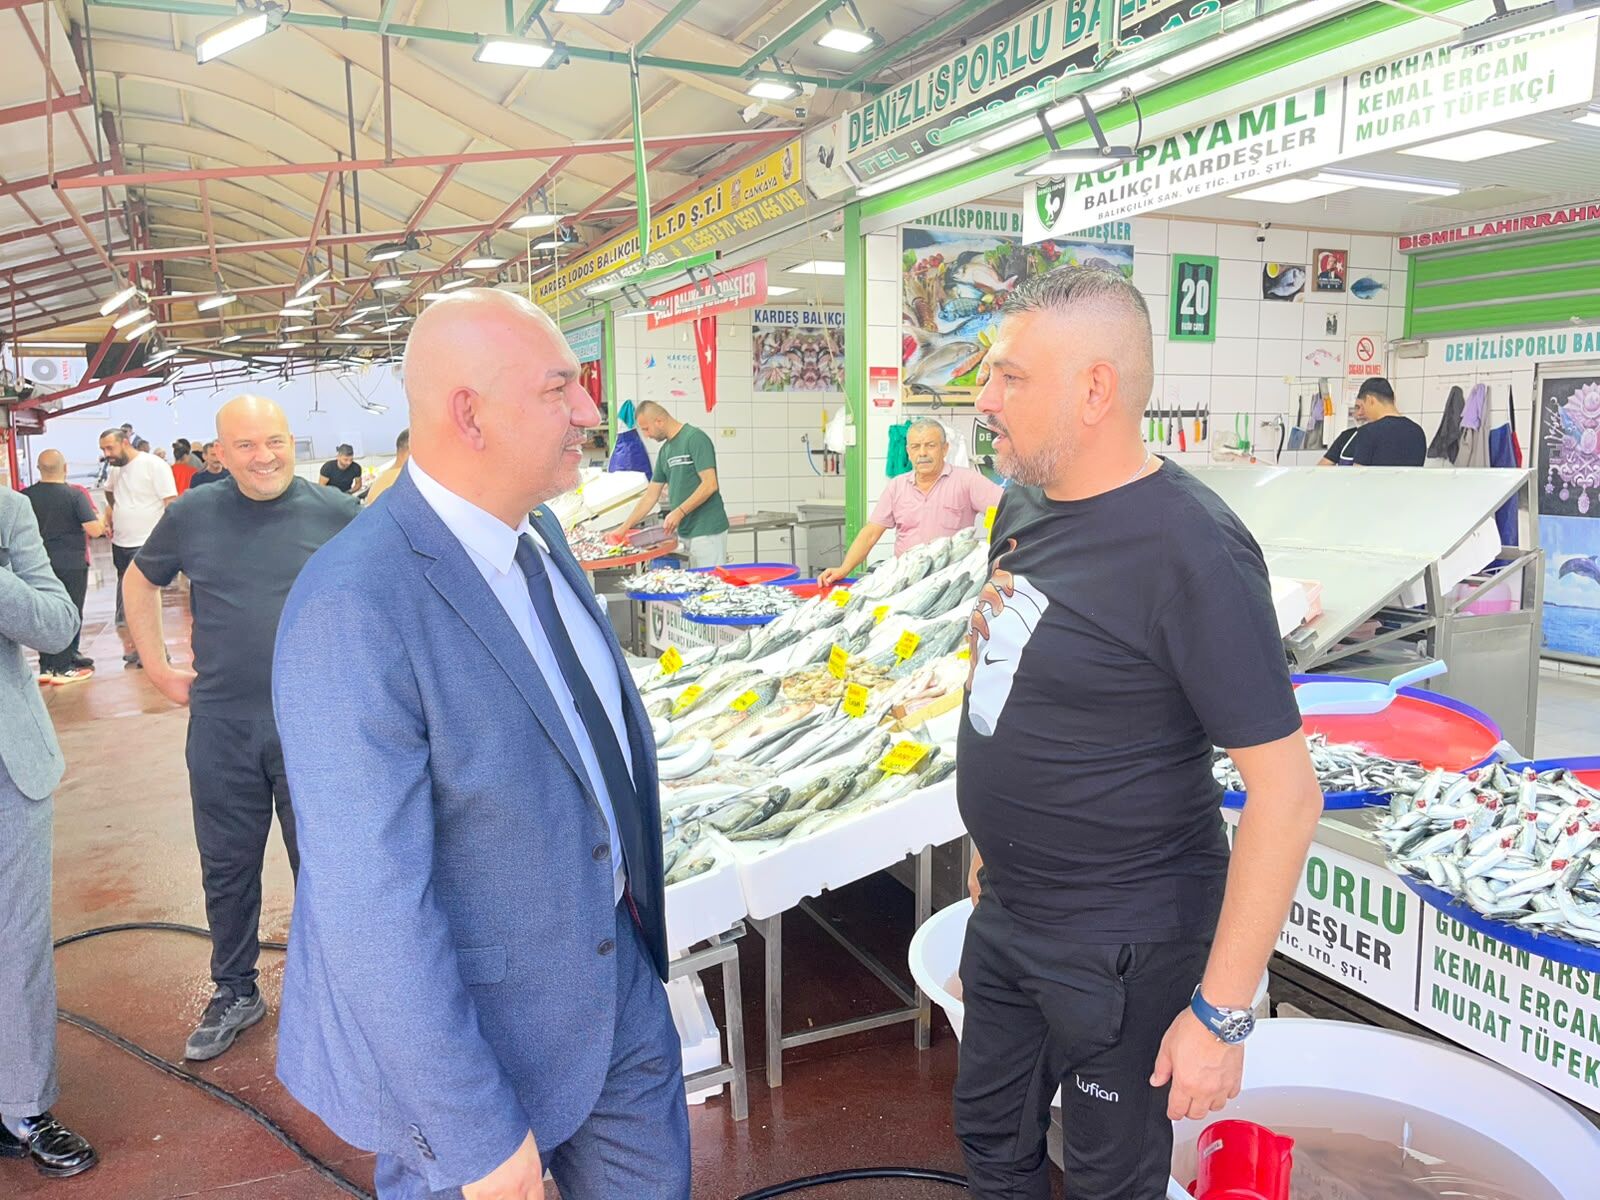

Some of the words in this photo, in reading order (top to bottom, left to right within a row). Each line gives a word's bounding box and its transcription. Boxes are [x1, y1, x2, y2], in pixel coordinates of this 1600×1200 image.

[1356, 105, 1435, 142] MURAT
[1444, 69, 1557, 119] TÜFEKÇİ
[1358, 79, 1433, 116] KEMAL
[1443, 52, 1528, 91] ERCAN
[857, 147, 909, 175] TEL
[1084, 176, 1161, 211] BALIKÇI
[1169, 127, 1317, 185] KARDEŞLER
[1098, 196, 1154, 220] BALIKÇILIK
[1157, 189, 1183, 204] SAN.
[1187, 184, 1202, 195] VE
[1234, 168, 1261, 182] LTD.
[569, 260, 594, 282] LODOS
[657, 215, 686, 239] L.T.D
[754, 309, 799, 328] KARDEŞ
[1180, 278, 1210, 315] 20
[1445, 335, 1567, 362] DENİZLİSPORLU
[1306, 856, 1407, 935] ORLU
[1289, 902, 1392, 970] DEŞLER
[1308, 944, 1335, 968] LTD.
[1340, 961, 1368, 984] ŞTİ.
[1434, 945, 1510, 1004] KEMAL
[1520, 984, 1600, 1045] ERCAN
[1432, 984, 1511, 1043] MURAT
[1520, 1025, 1600, 1090] TÜFEK
